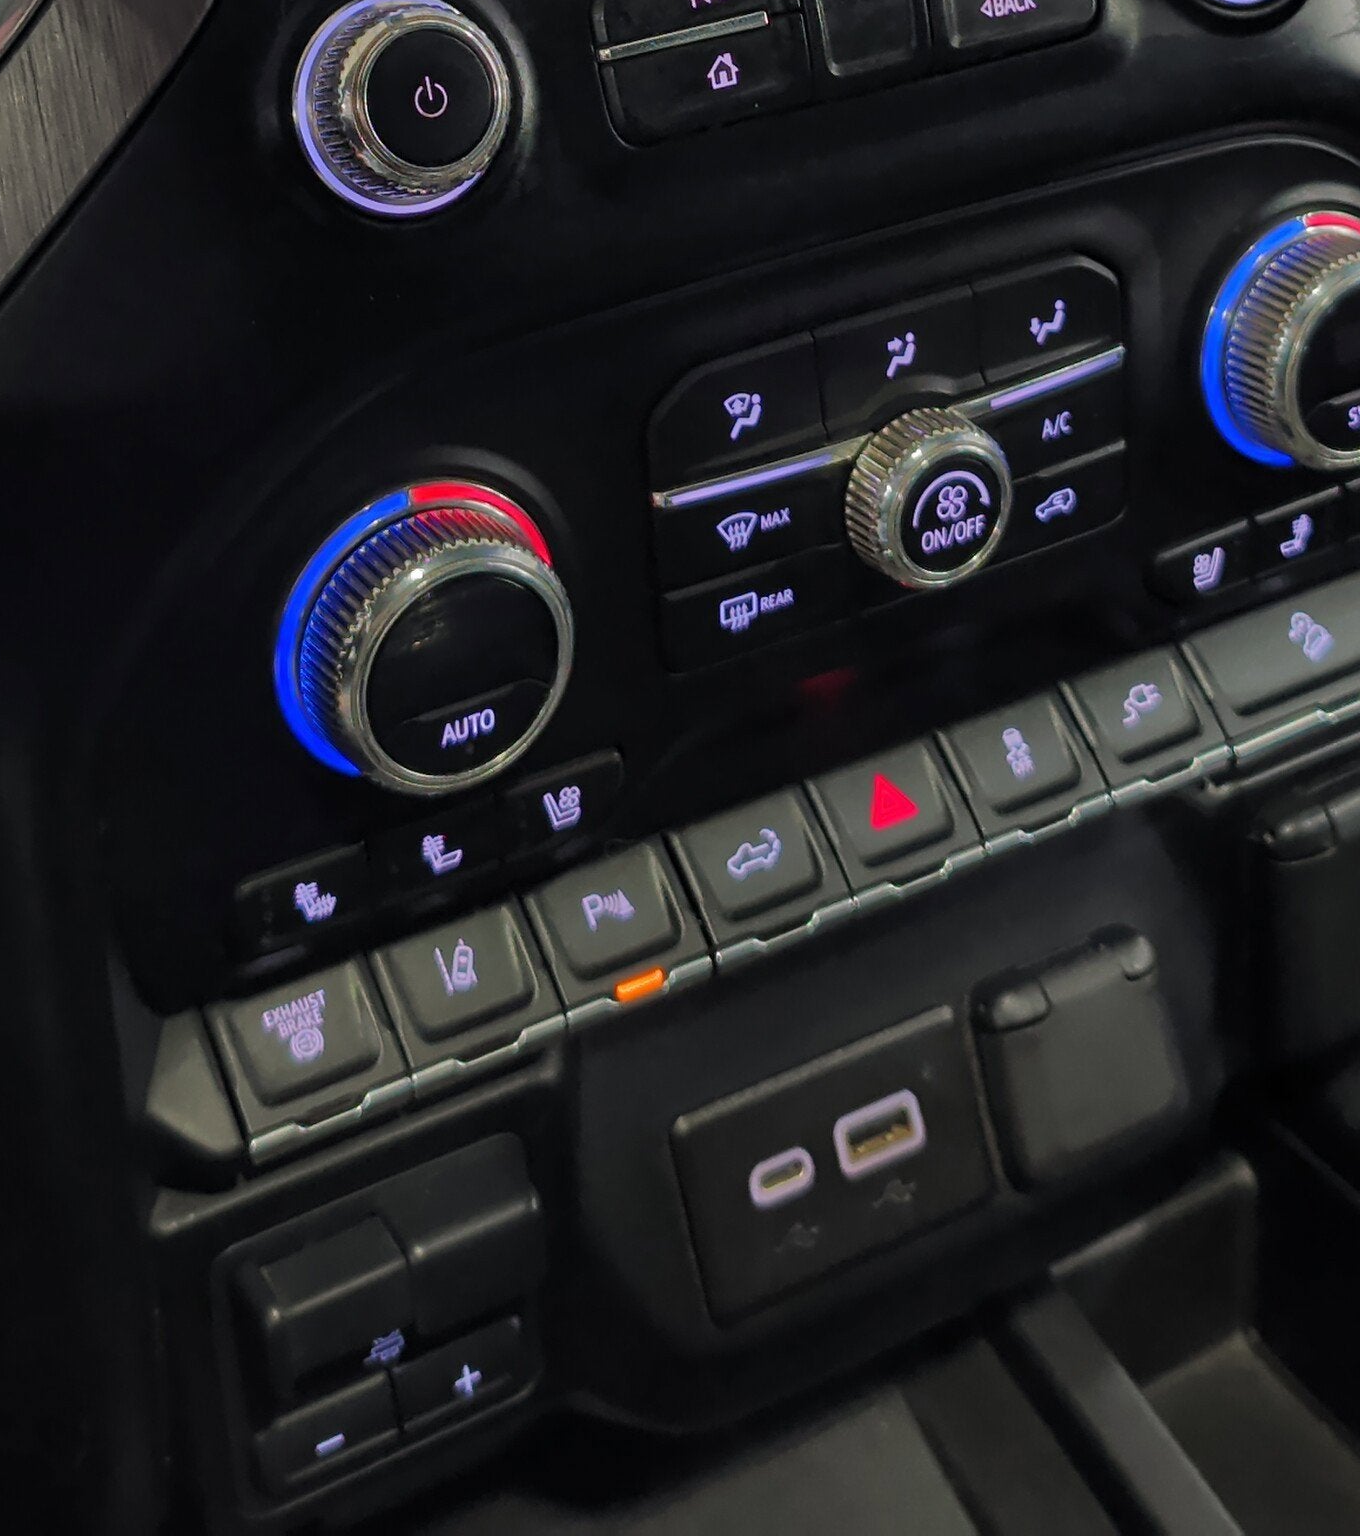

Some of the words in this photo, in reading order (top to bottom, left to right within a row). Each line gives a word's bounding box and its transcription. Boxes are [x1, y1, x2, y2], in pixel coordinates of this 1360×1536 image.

[1041, 411, 1073, 441] A/C
[760, 507, 791, 532] MAX
[921, 514, 987, 555] ON/OFF
[760, 588, 794, 613] REAR
[441, 708, 495, 749] AUTO
[262, 989, 326, 1029] EXHAUST
[278, 1007, 324, 1040] BRAKE
